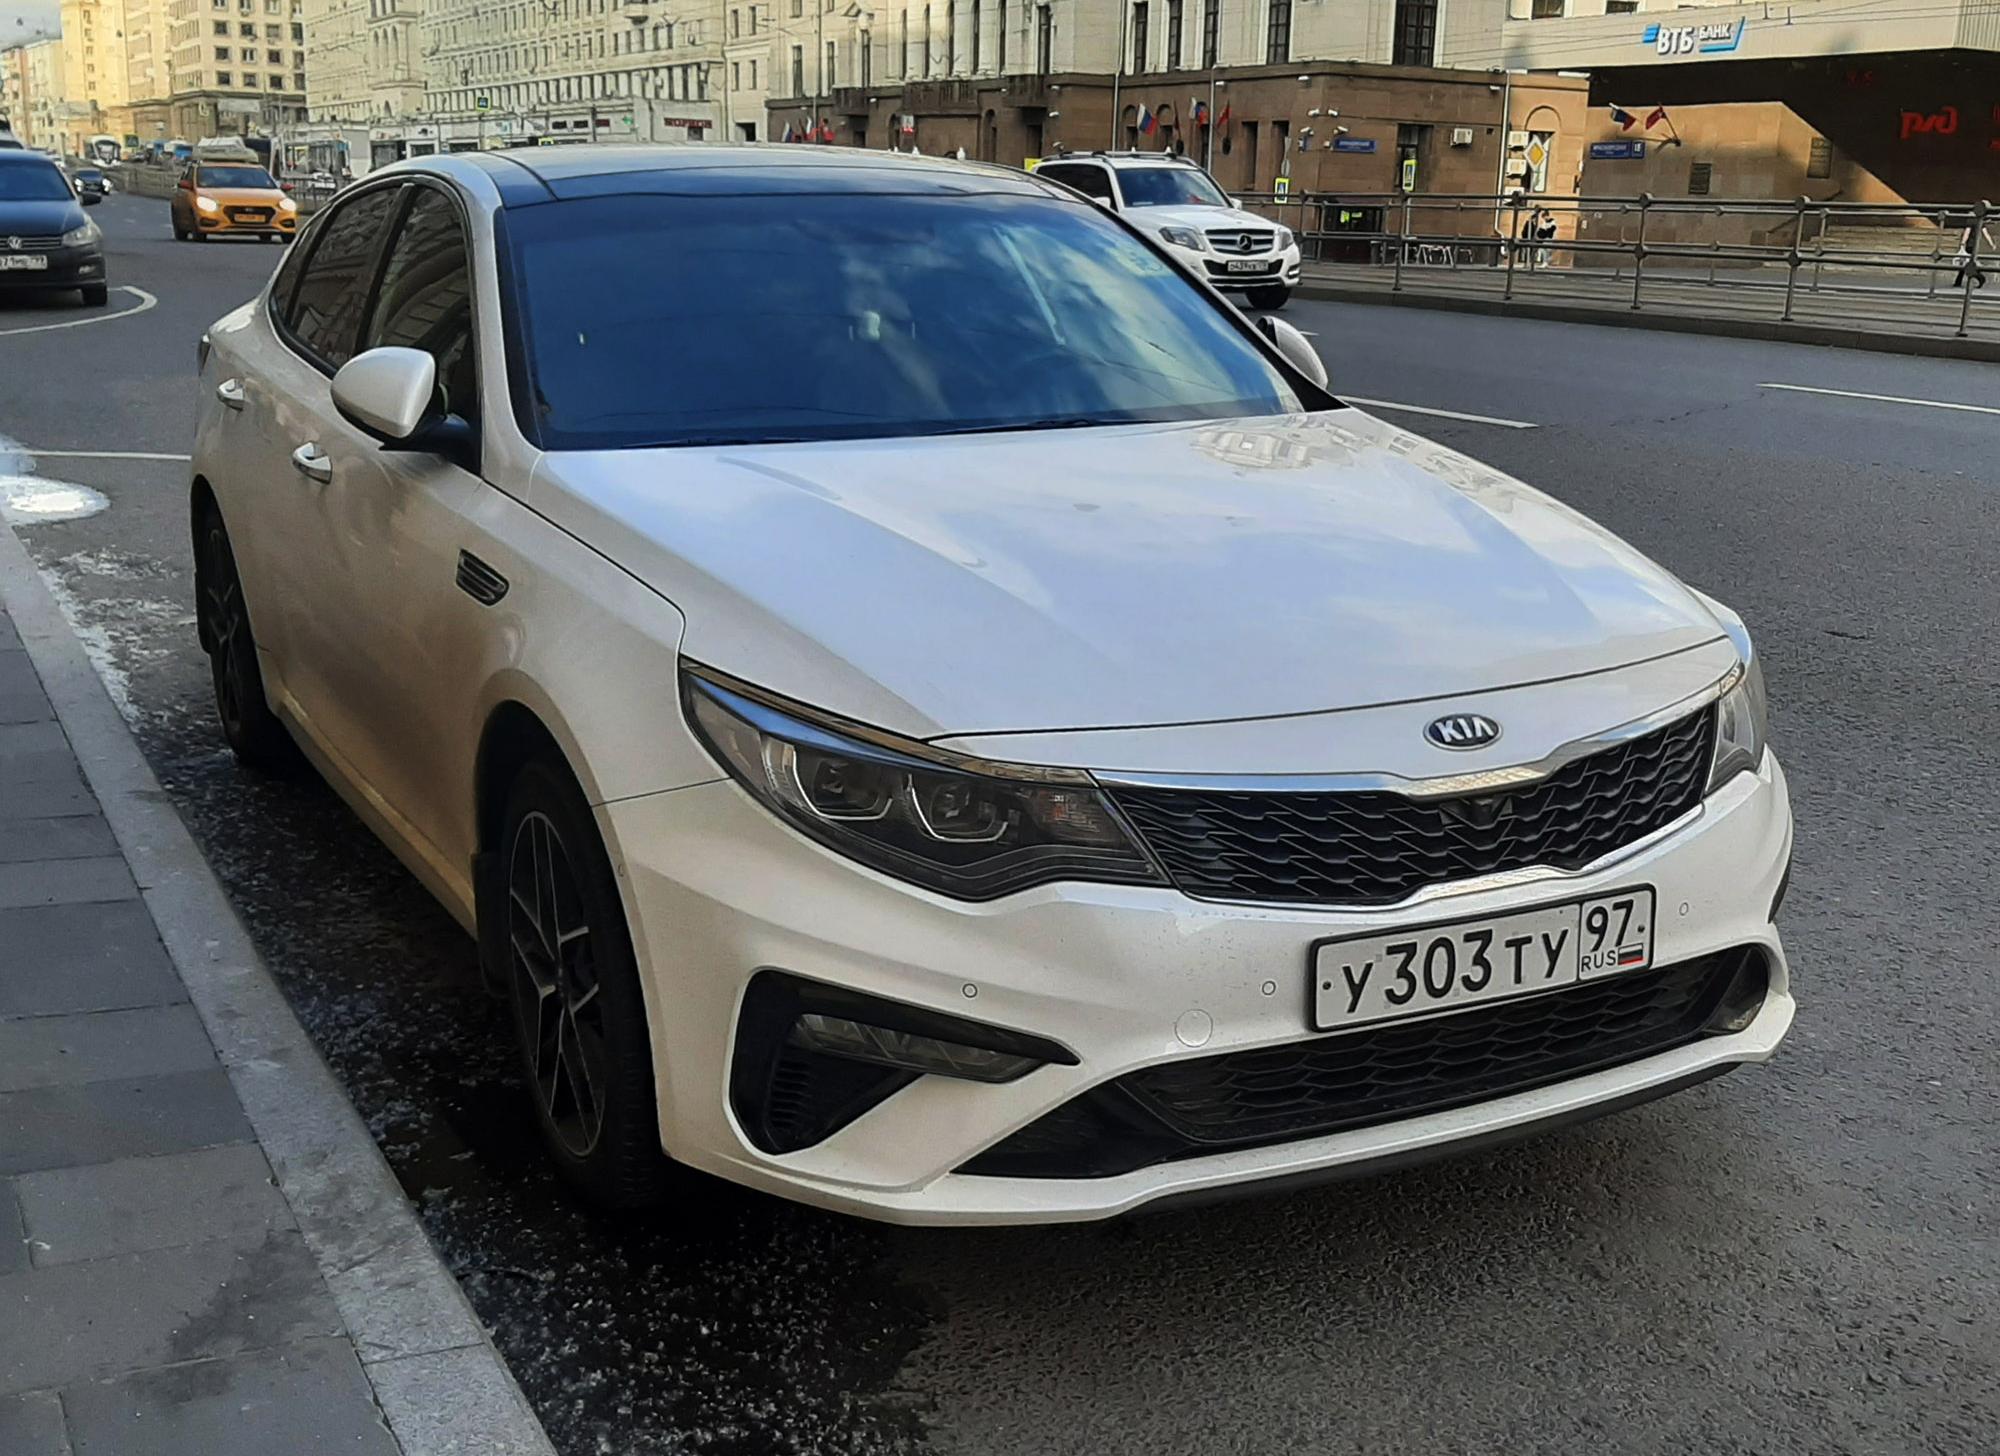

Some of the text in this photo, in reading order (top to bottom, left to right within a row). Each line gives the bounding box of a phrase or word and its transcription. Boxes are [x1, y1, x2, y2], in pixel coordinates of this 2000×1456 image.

[1657, 23, 1732, 55] ВТБ БАНК
[1435, 717, 1495, 743] KIA
[1585, 899, 1635, 954] 97
[1581, 950, 1616, 972] RUS
